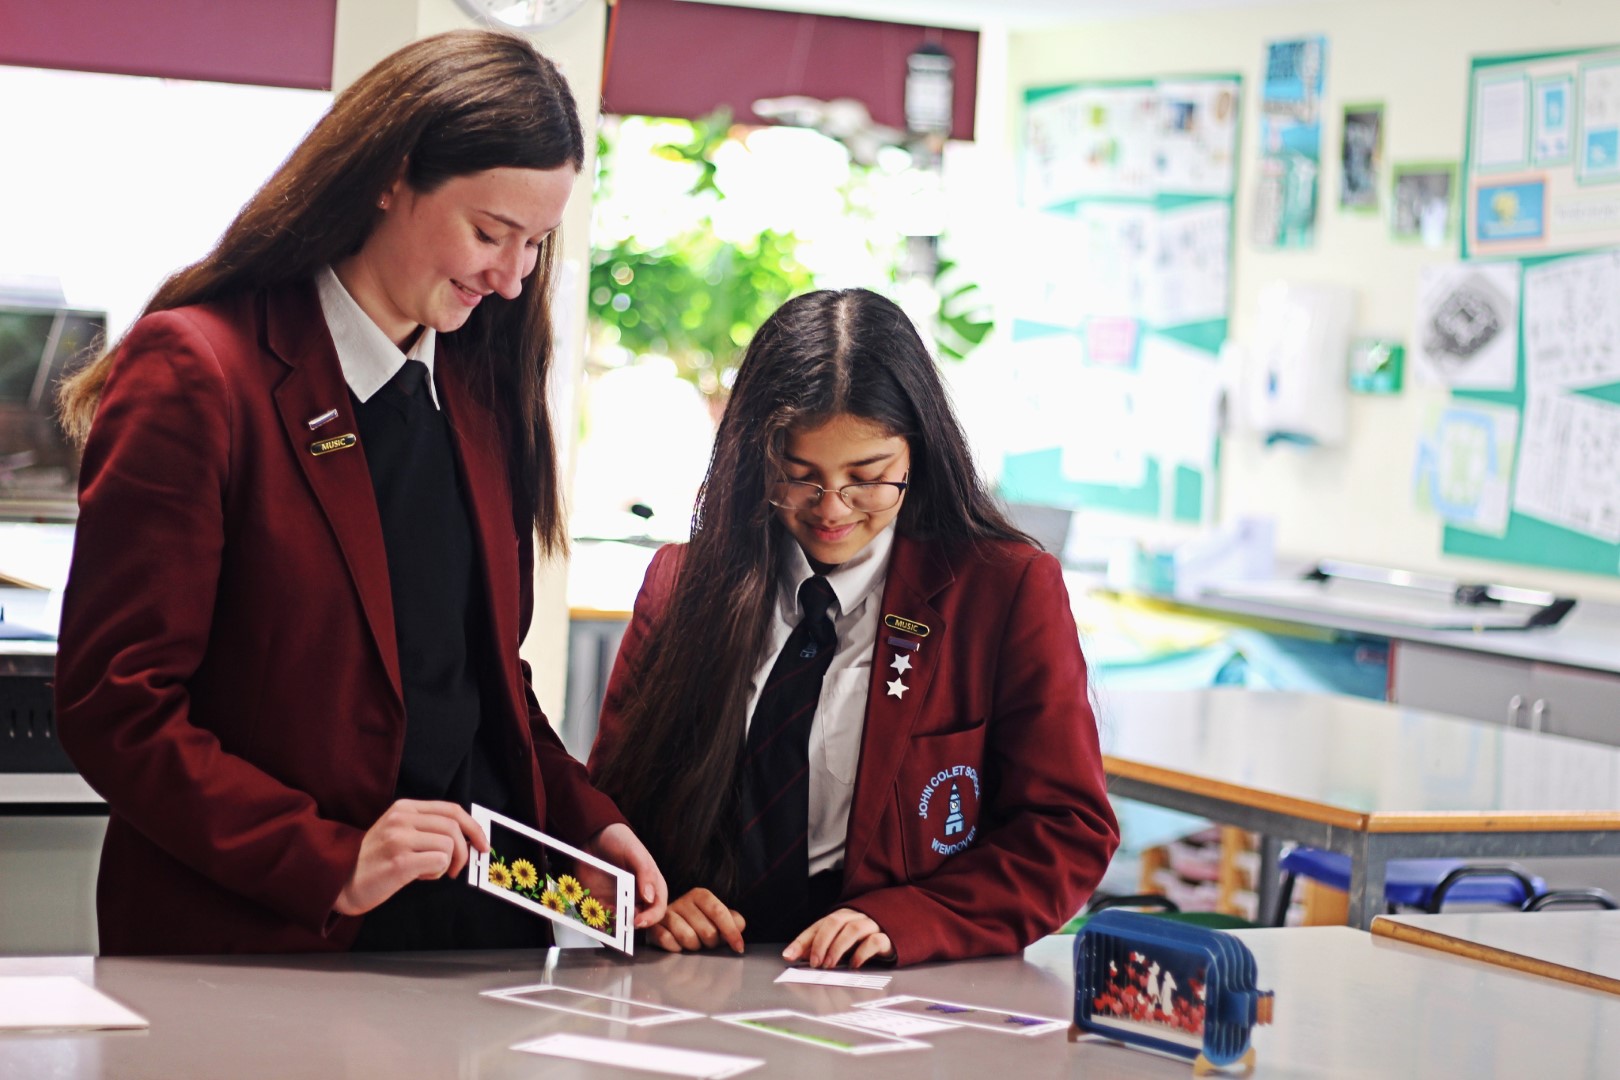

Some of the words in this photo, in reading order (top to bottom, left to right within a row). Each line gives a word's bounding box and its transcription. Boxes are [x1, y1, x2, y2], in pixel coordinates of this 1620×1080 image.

[321, 438, 346, 451] MUSIC
[894, 619, 919, 632] MUSIC
[918, 785, 935, 820] JOHN
[930, 765, 966, 787] COLET
